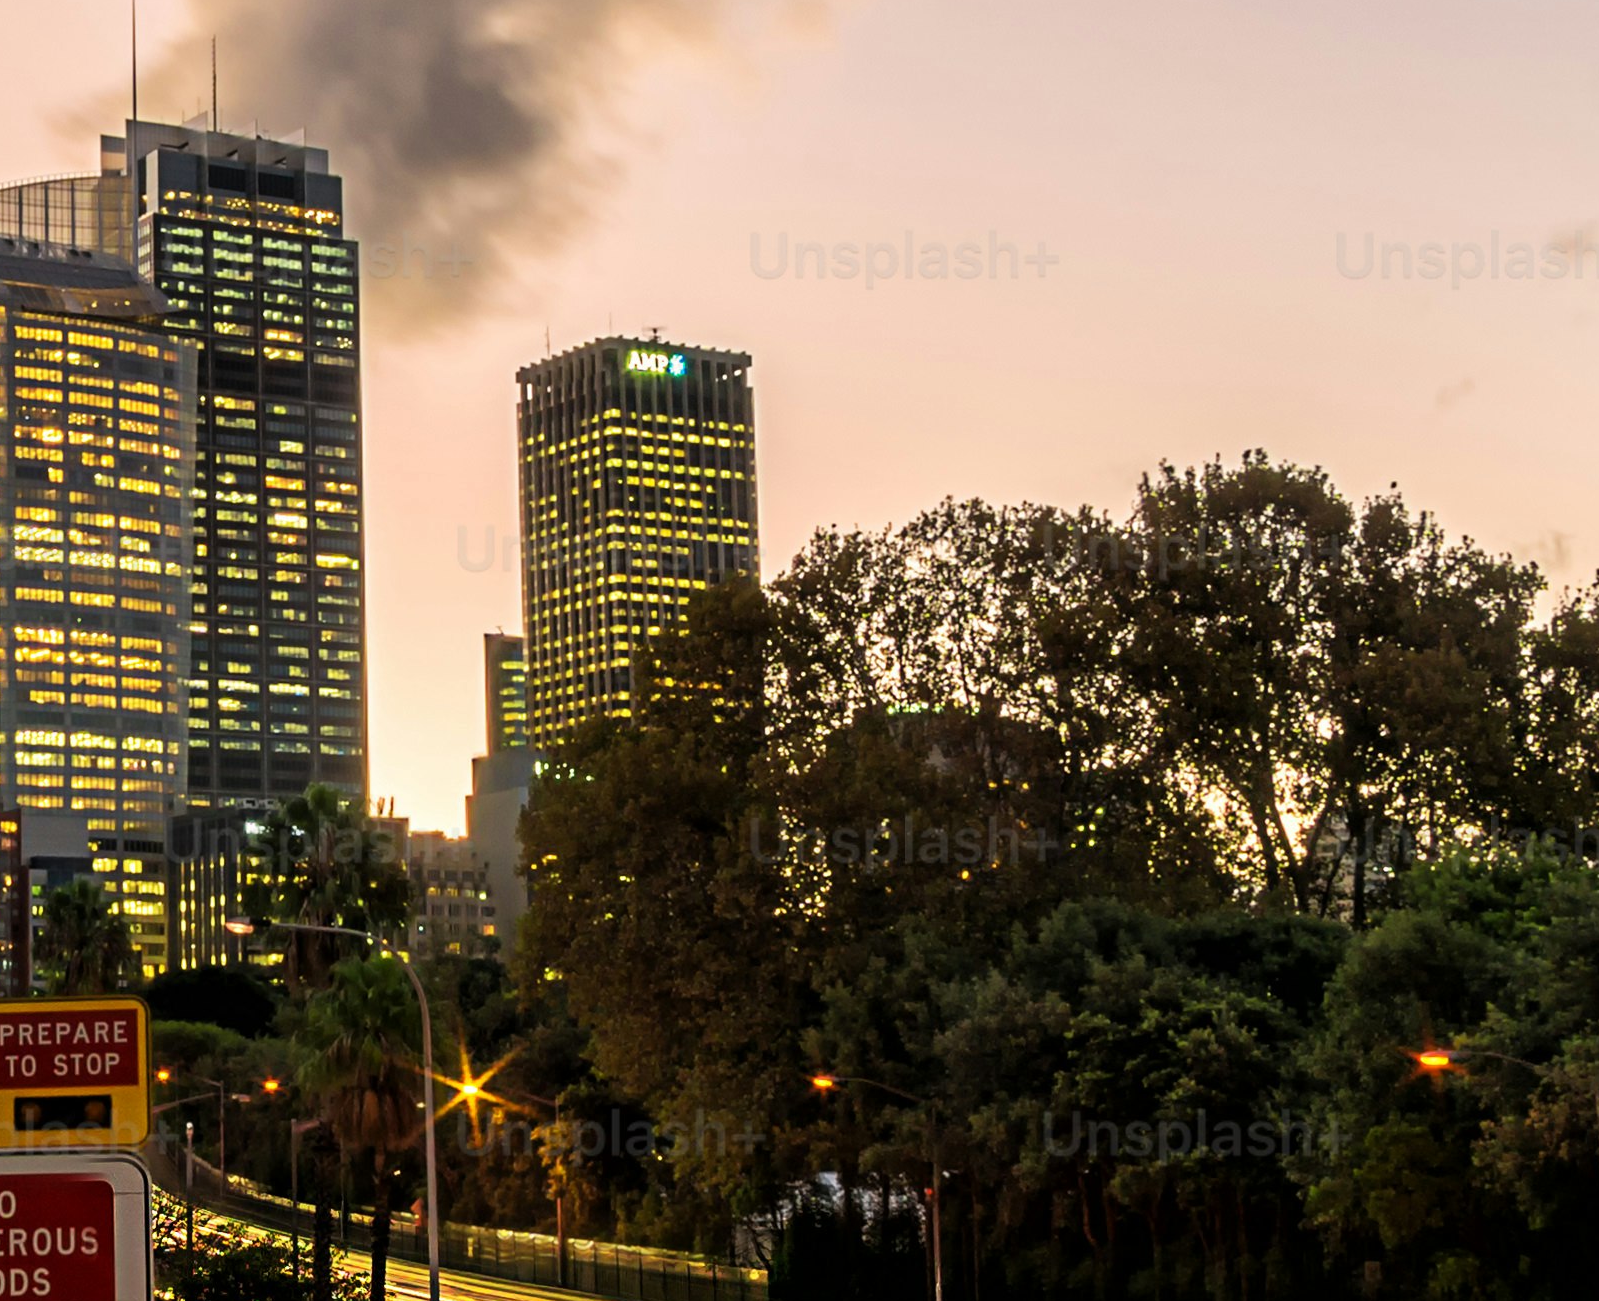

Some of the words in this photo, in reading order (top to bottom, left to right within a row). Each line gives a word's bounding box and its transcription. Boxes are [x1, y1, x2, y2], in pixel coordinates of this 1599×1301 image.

[628, 350, 669, 373] AMP
[0, 1020, 128, 1046] PREPARE
[5, 1055, 37, 1077] TO
[53, 1053, 120, 1077] STOP
